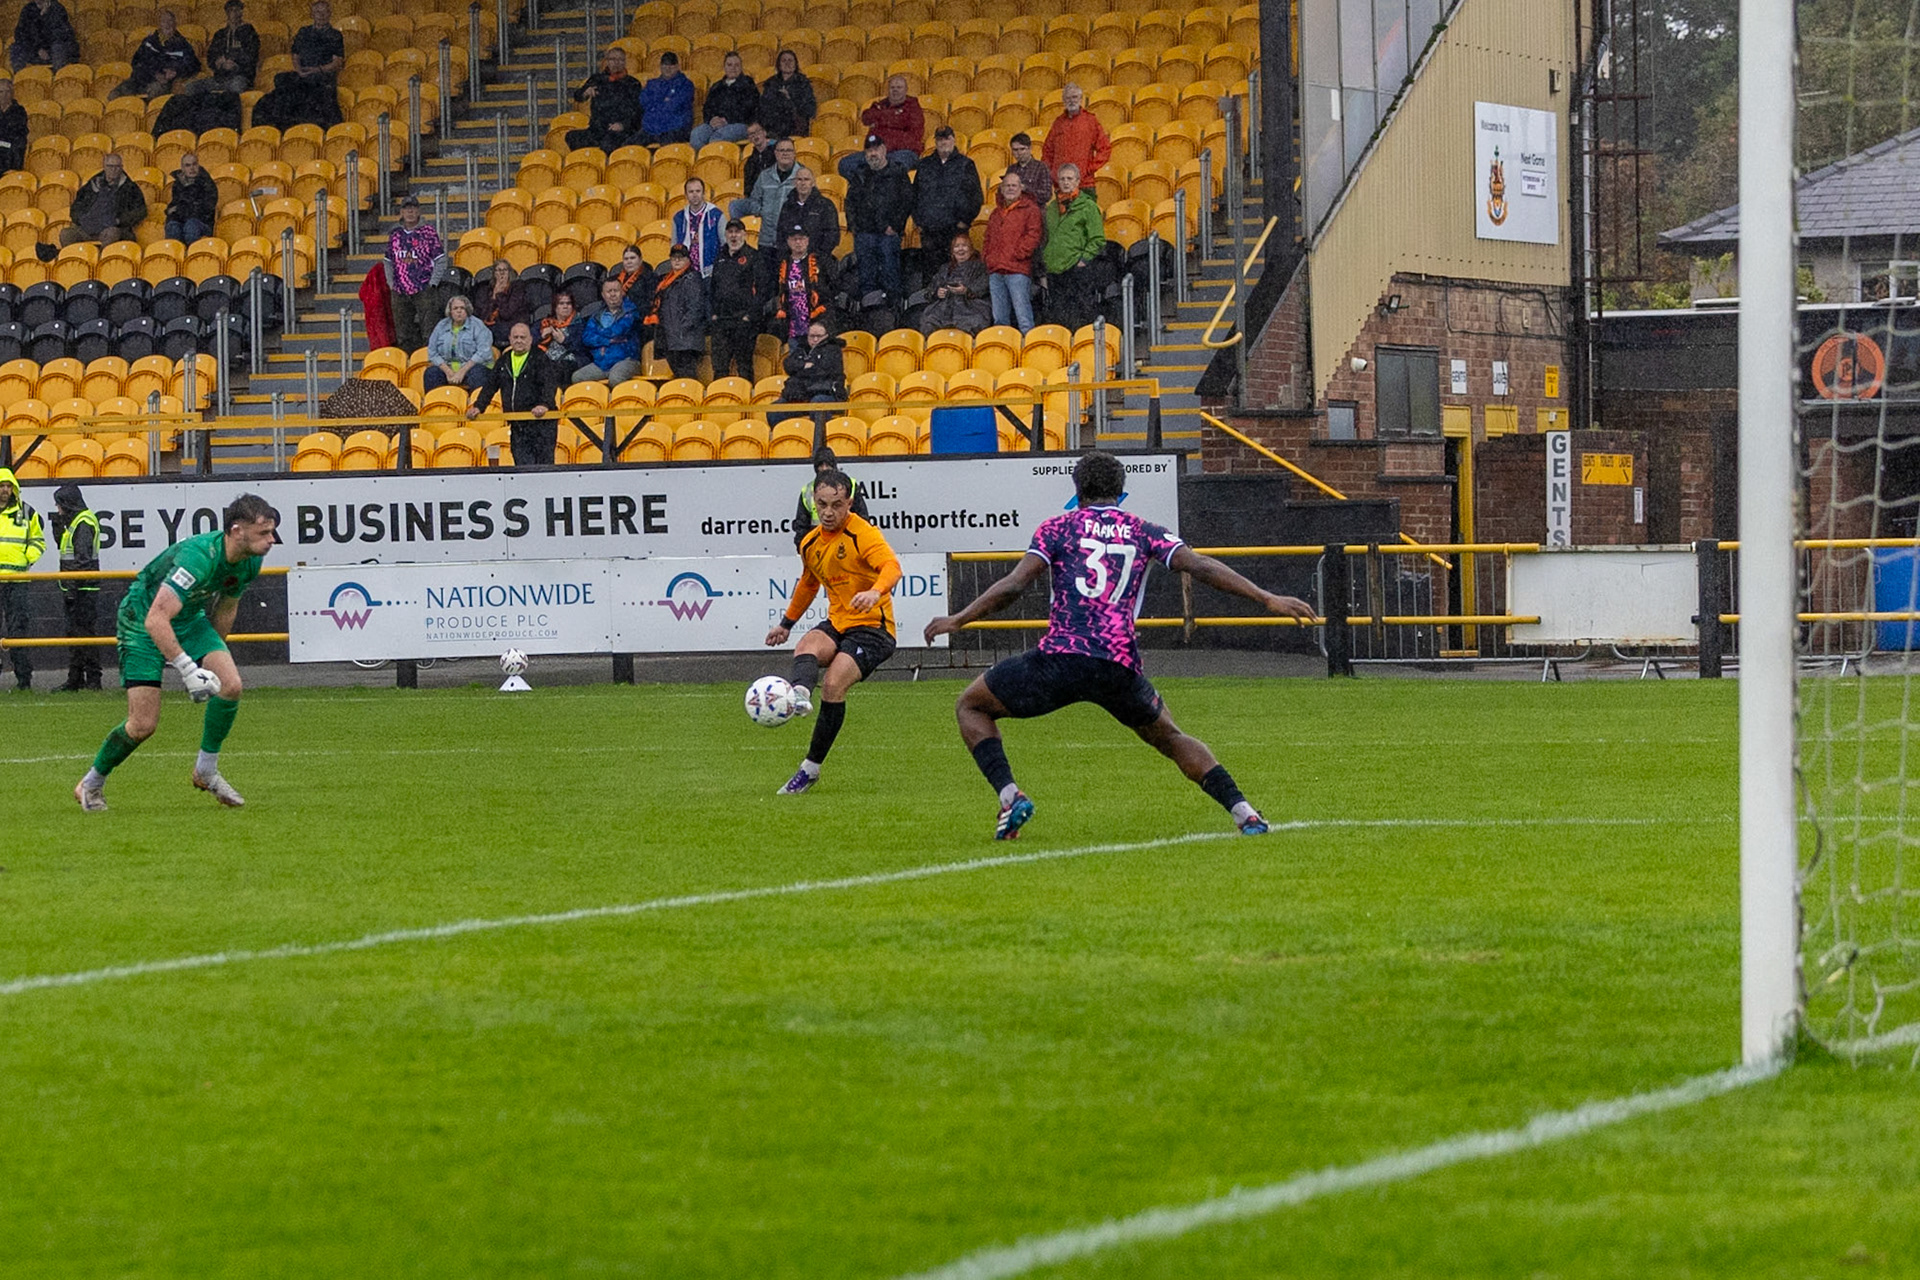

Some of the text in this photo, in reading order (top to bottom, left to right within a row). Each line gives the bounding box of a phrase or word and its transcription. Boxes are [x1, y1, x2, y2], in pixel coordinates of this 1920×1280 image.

[1032, 466, 1074, 476] SUPPLIE
[1154, 463, 1168, 473] BY
[857, 480, 897, 500] AIL:
[1552, 434, 1566, 547] GENTS
[297, 499, 530, 544] BUSINESS
[545, 495, 669, 537] HERE
[1075, 537, 1137, 604] 37
[426, 583, 595, 609] NATIONWIDE
[426, 614, 549, 629] PRODUCE PLC
[426, 629, 558, 640] NATIONWIDEPRODUCE.COM
